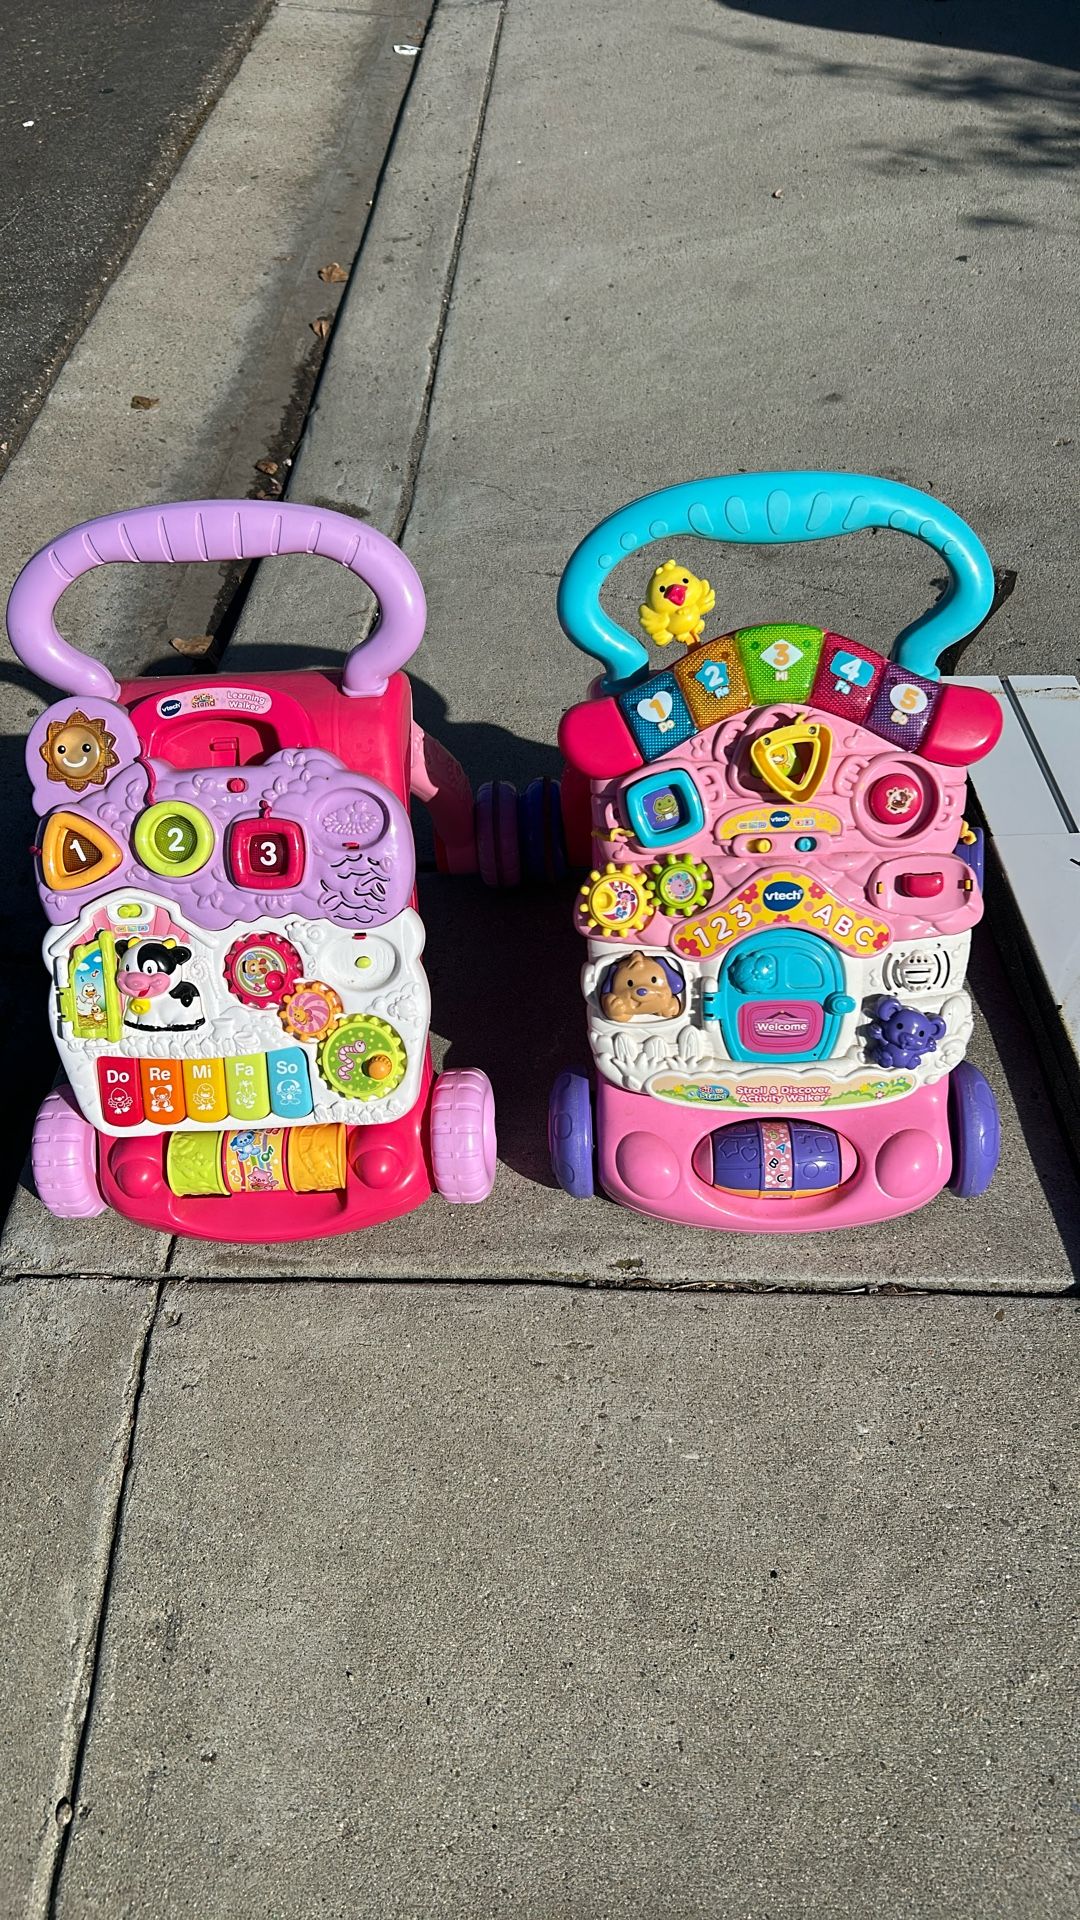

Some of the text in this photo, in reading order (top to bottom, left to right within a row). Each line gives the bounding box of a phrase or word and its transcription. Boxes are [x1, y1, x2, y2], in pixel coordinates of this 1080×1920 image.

[773, 643, 789, 666] 3
[704, 665, 724, 687] 2
[839, 658, 863, 682] 4
[226, 690, 266, 706] Learning
[900, 688, 919, 710] 5
[161, 702, 181, 713] vtech
[228, 701, 260, 712] Walker
[649, 698, 666, 719] 1
[770, 815, 790, 823] vtech
[167, 827, 186, 852] 2
[69, 839, 87, 862] 1
[259, 841, 278, 866] 3
[764, 890, 803, 901] vtech
[757, 1022, 808, 1031] Welcome
[149, 1067, 171, 1081] Re
[192, 1065, 212, 1079] Mi
[235, 1062, 254, 1077] Fa
[276, 1060, 299, 1075] So
[106, 1069, 130, 1084] Do
[736, 1085, 830, 1095] Stroll & Discover
[739, 1094, 826, 1103] Activity Walker
[775, 1143, 786, 1154] A
[768, 1157, 779, 1168] B
[776, 1173, 787, 1183] C
